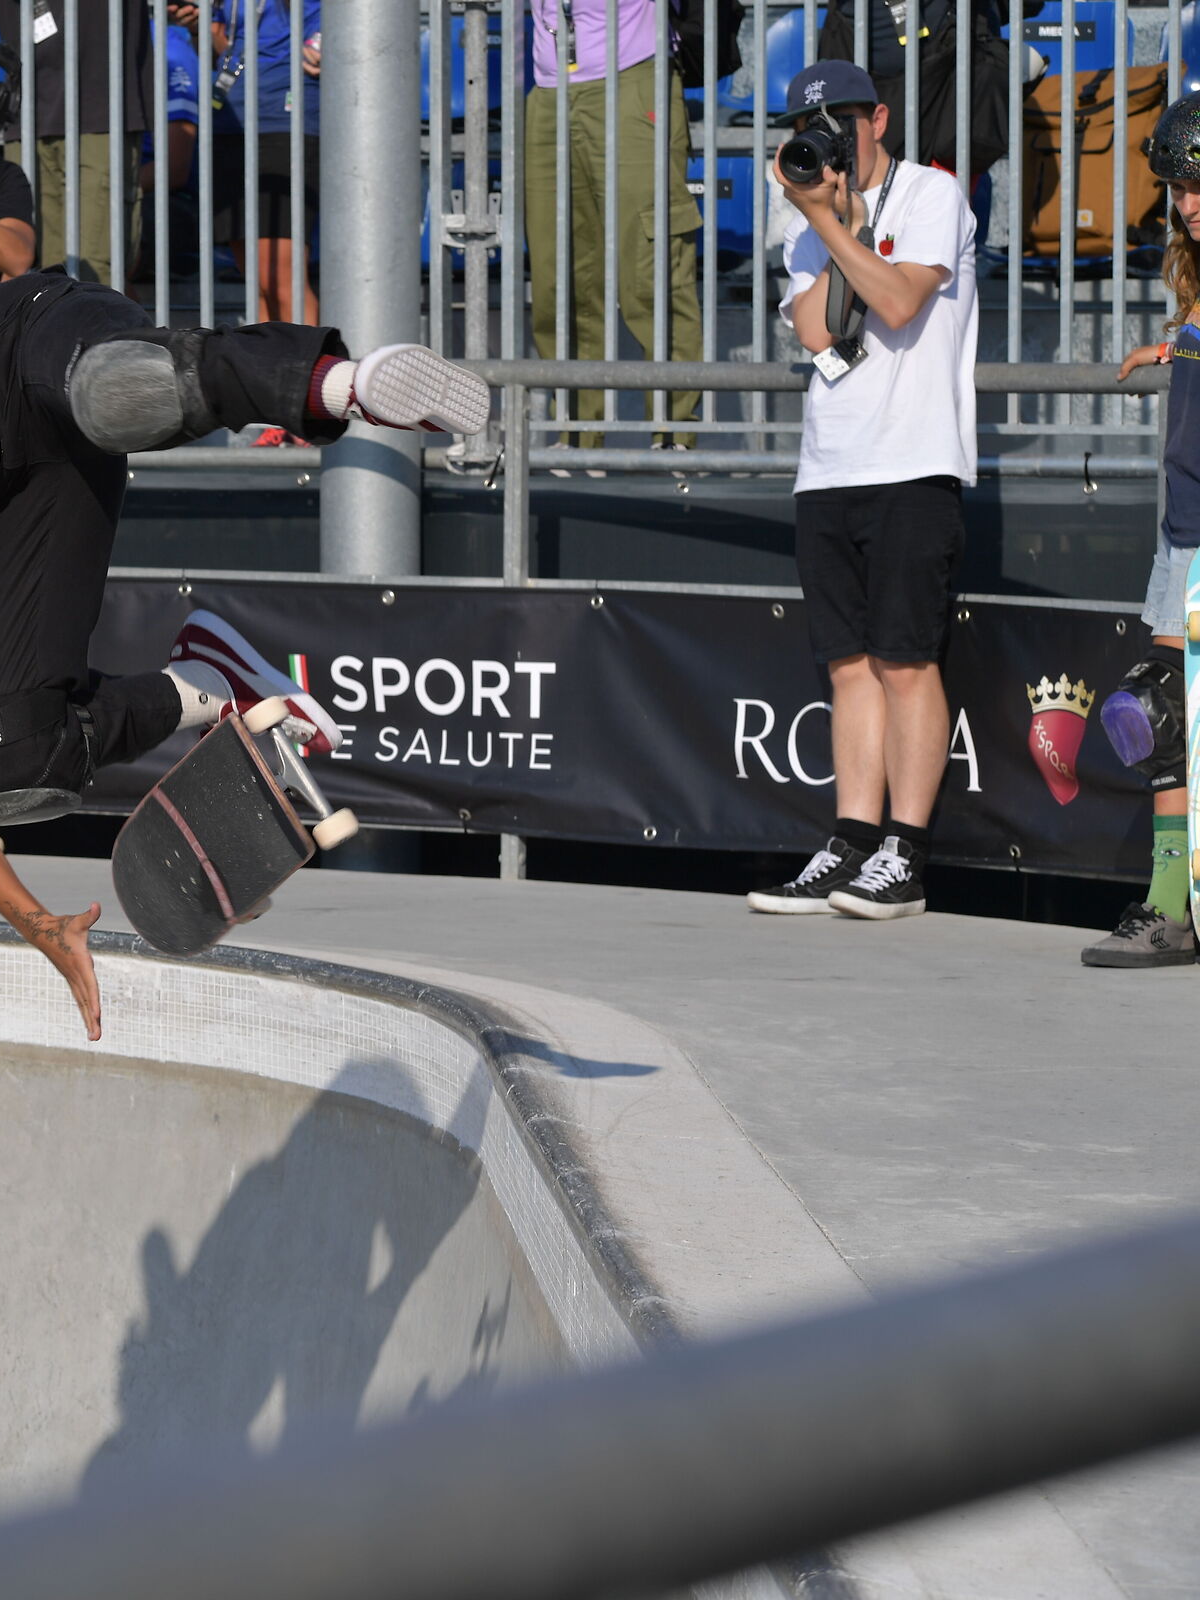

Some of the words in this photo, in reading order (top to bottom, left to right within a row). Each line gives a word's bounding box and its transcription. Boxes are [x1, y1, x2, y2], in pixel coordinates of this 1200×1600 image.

[1038, 25, 1080, 37] MEDA
[330, 655, 557, 719] SPORT
[330, 724, 357, 760] E
[374, 726, 554, 770] SALUTE
[733, 697, 983, 793] ROA
